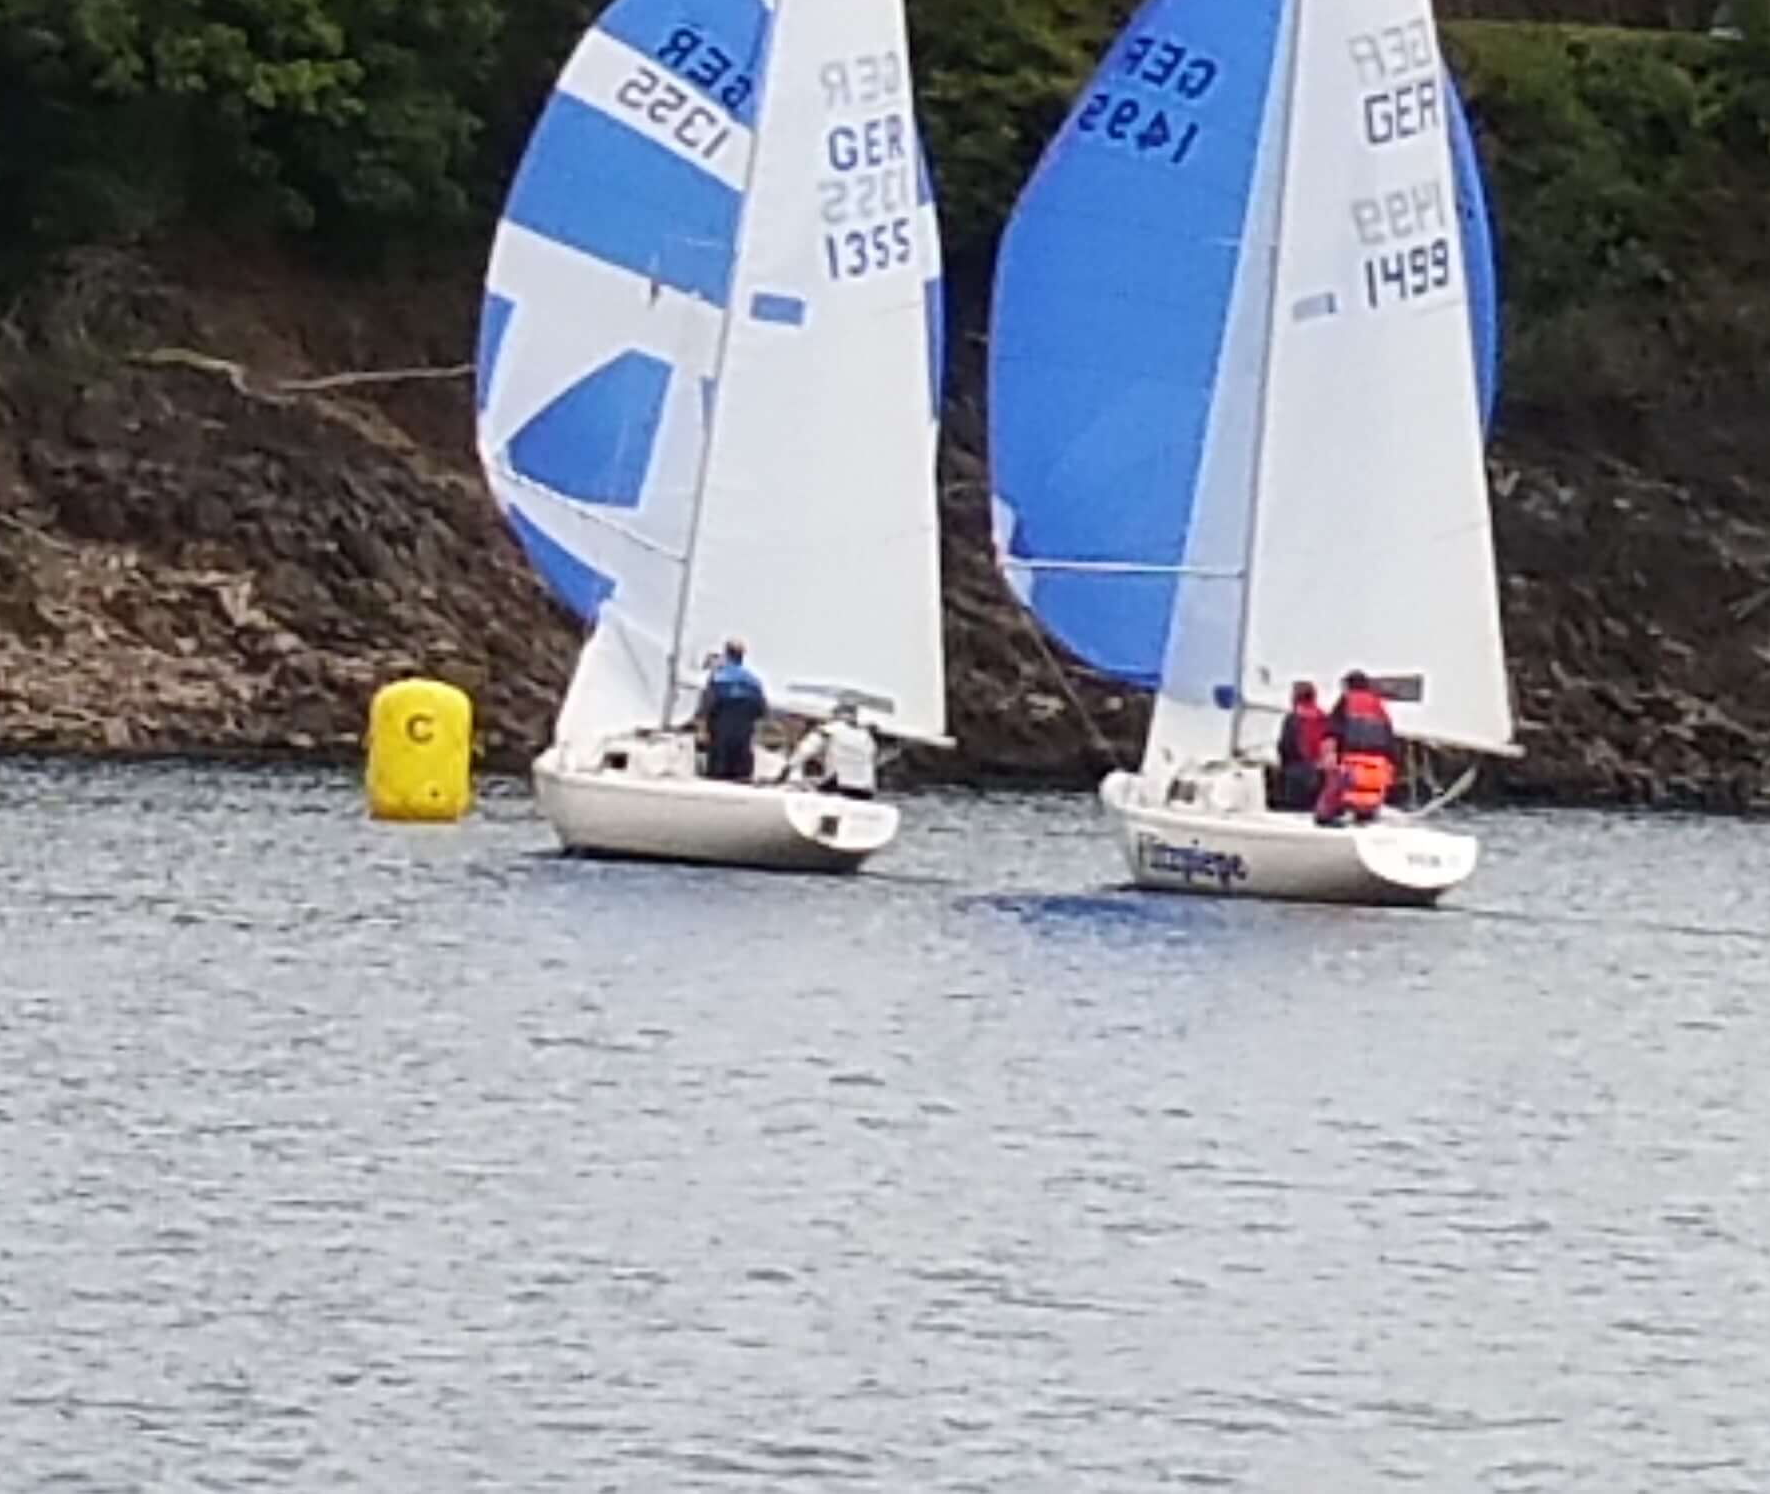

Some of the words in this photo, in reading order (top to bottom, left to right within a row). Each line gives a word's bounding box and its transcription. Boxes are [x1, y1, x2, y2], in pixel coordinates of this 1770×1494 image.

[828, 113, 906, 172] GER
[825, 216, 911, 281] 1355
[1364, 237, 1449, 310] 1499
[405, 712, 435, 744] C
